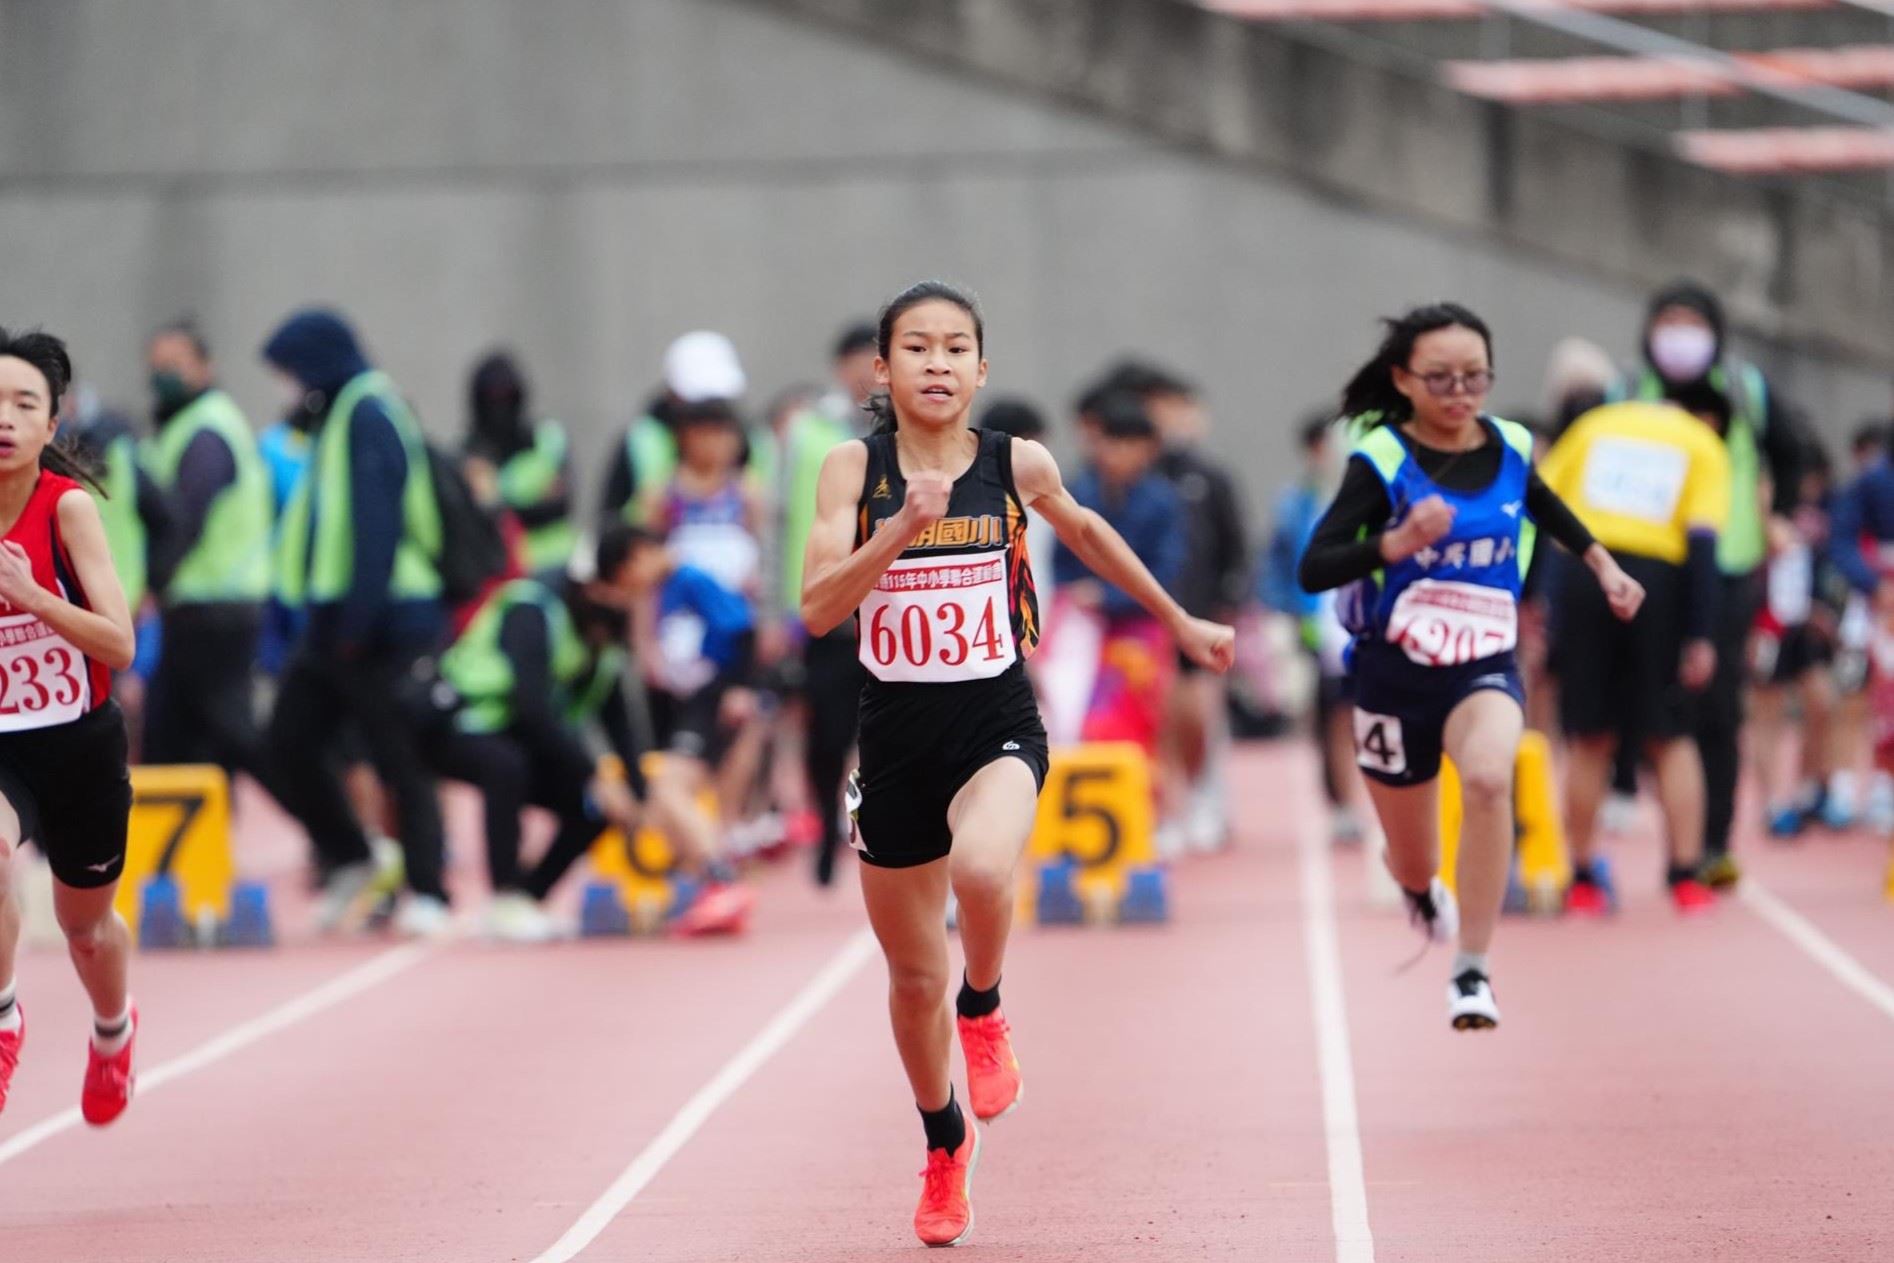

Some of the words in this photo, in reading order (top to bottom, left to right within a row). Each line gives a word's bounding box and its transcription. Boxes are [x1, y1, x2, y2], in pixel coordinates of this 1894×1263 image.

[870, 596, 1005, 667] 6034
[1363, 721, 1396, 766] 4
[135, 796, 206, 874] 7
[1060, 767, 1120, 867] 5
